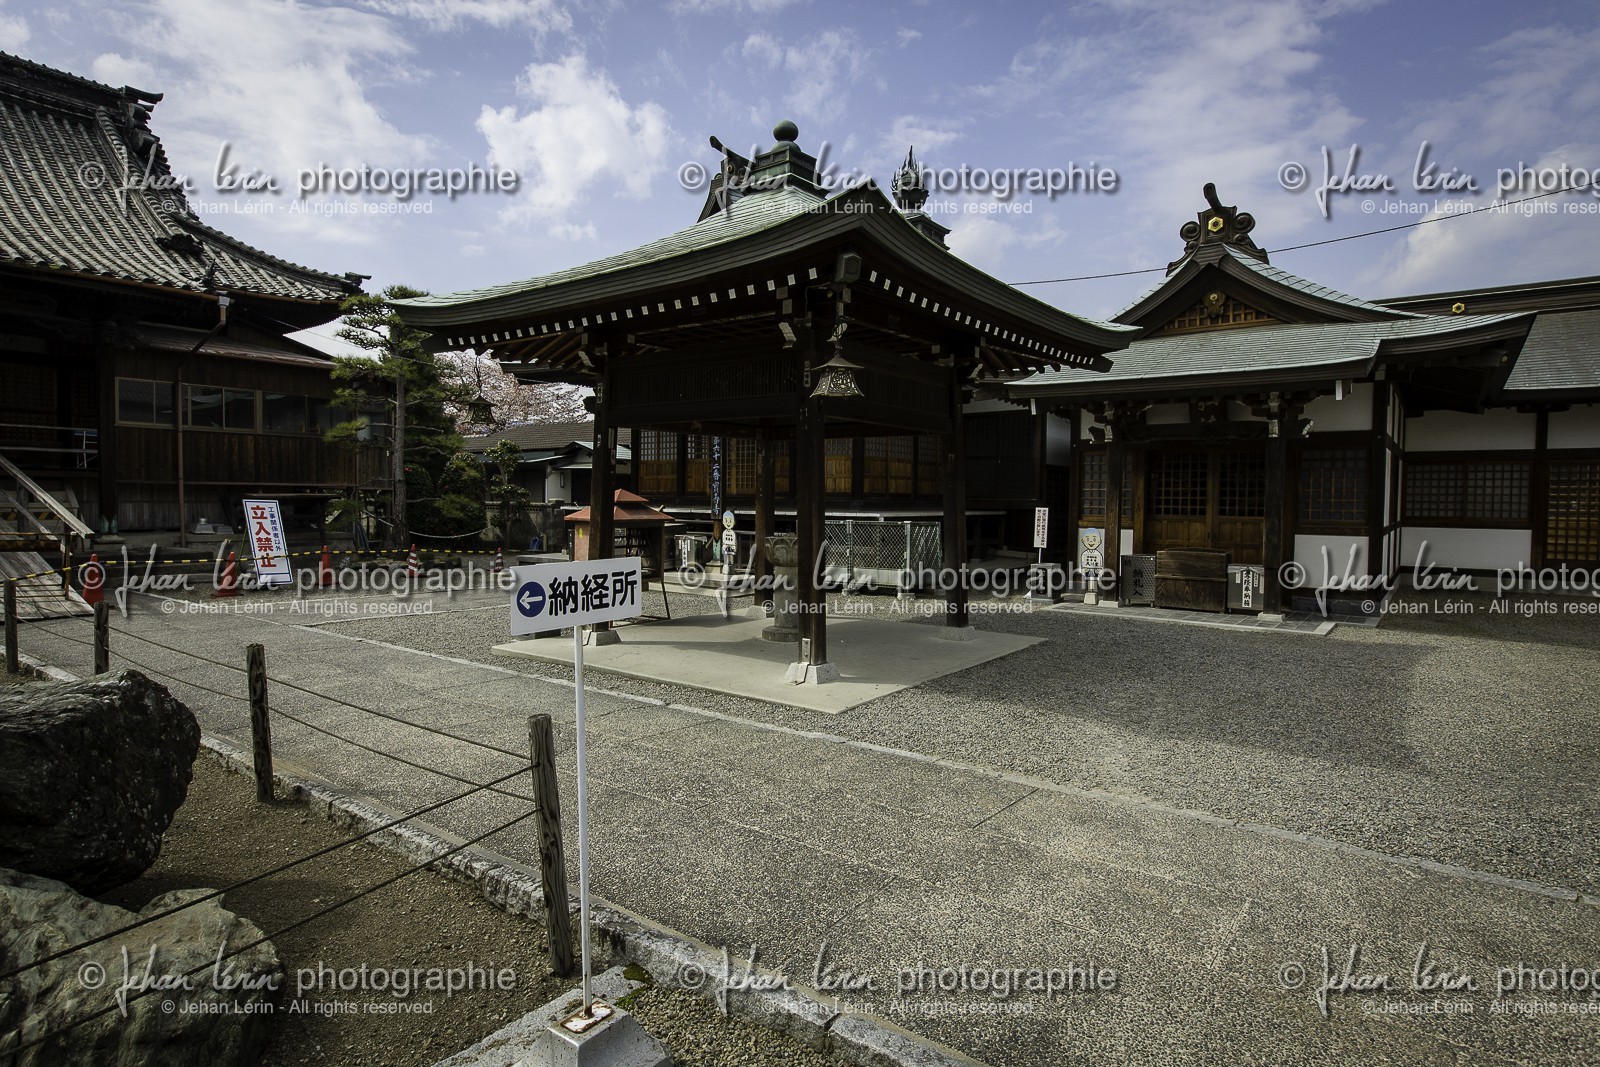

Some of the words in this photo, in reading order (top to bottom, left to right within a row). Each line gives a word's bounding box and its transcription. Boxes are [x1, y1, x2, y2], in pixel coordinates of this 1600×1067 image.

[251, 505, 277, 568] 立入禁止
[267, 506, 282, 552] 工事関係者以外
[548, 569, 637, 616] 納経所
[1133, 568, 1144, 596] 納札入
